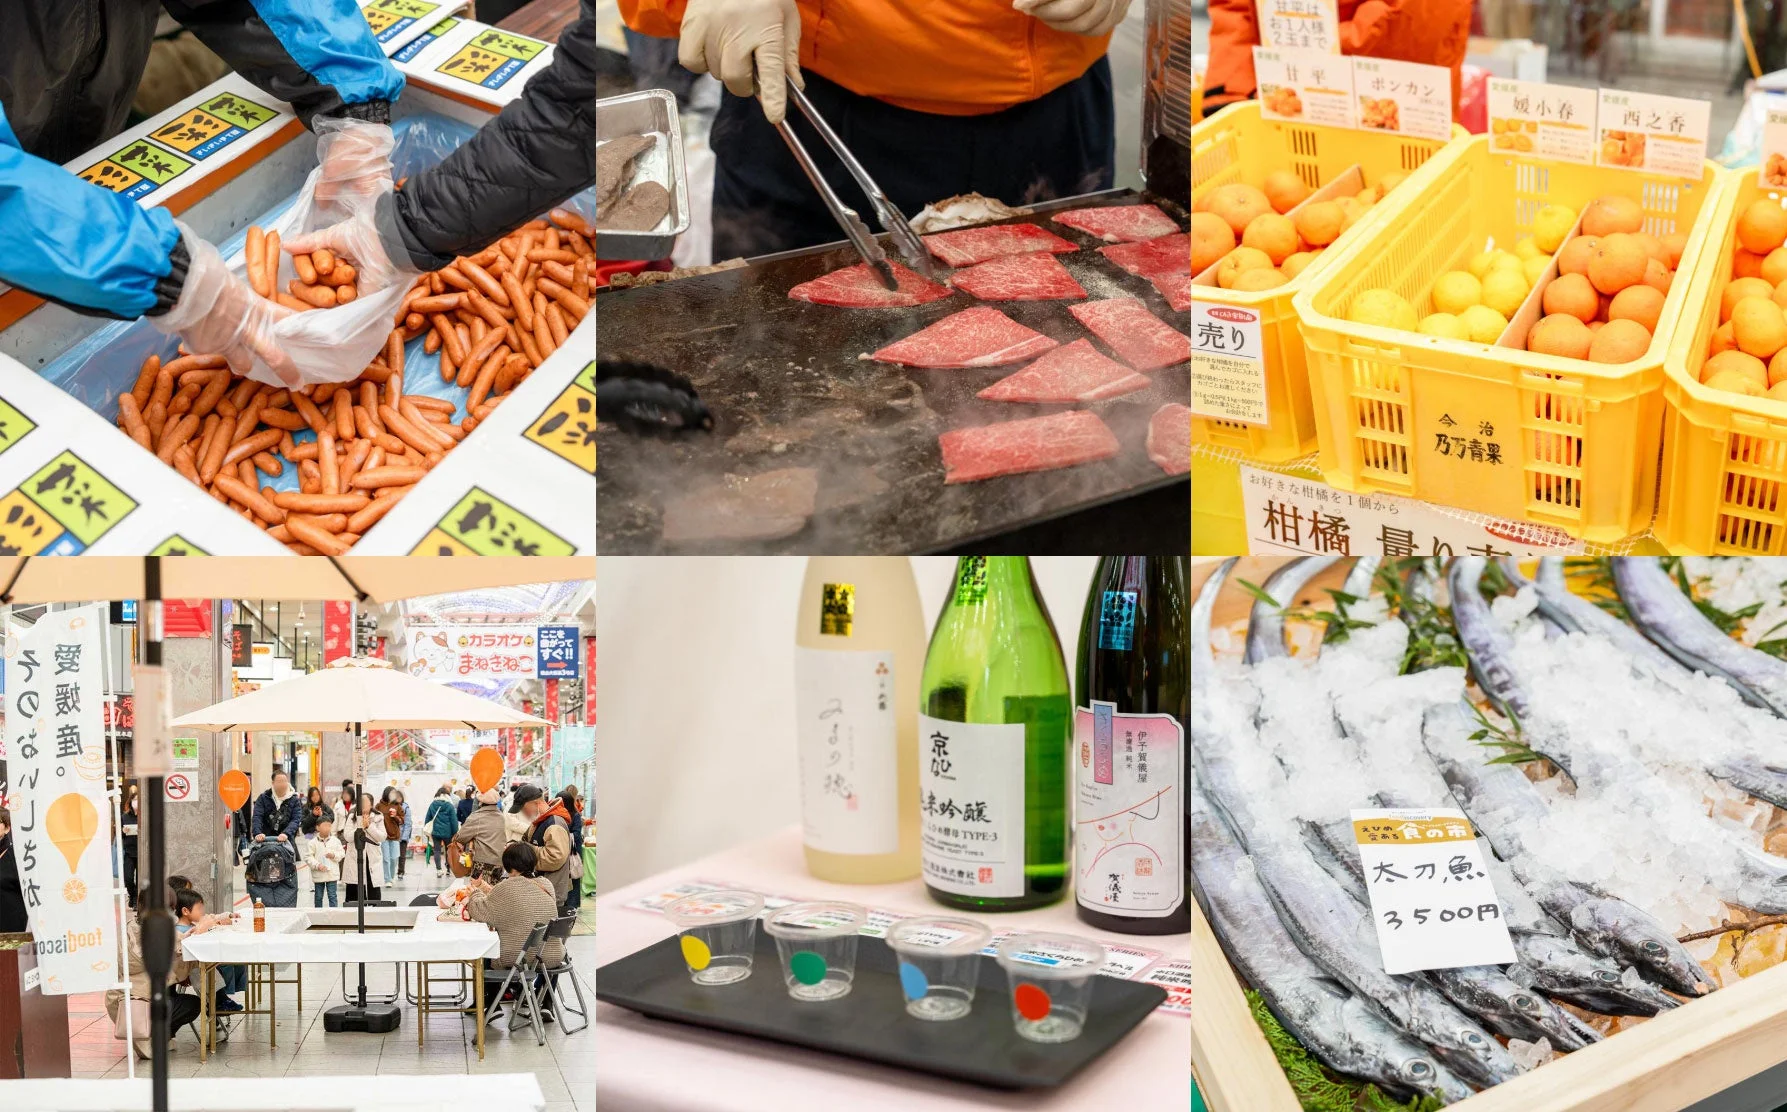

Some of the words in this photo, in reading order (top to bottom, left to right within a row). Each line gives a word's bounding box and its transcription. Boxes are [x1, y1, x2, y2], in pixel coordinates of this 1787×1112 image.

[1372, 77, 1435, 96] ポンカン
[1513, 95, 1575, 121] 媛小春
[1624, 109, 1686, 134] 西之香
[1197, 321, 1245, 351] 売り
[1439, 413, 1495, 437] 今治
[1434, 433, 1503, 465] 乃万青果
[1262, 500, 1350, 556] 柑橘
[469, 634, 524, 648] カラオケ
[541, 630, 565, 639] ここを
[458, 652, 534, 675] まねきねこ
[962, 830, 998, 842] TYPE-3
[1362, 825, 1393, 833] えひめ
[1396, 822, 1467, 840] 食の市
[1373, 855, 1485, 884] 太刀魚
[1383, 904, 1499, 930] 3500円
[1109, 947, 1147, 957] SERIES
